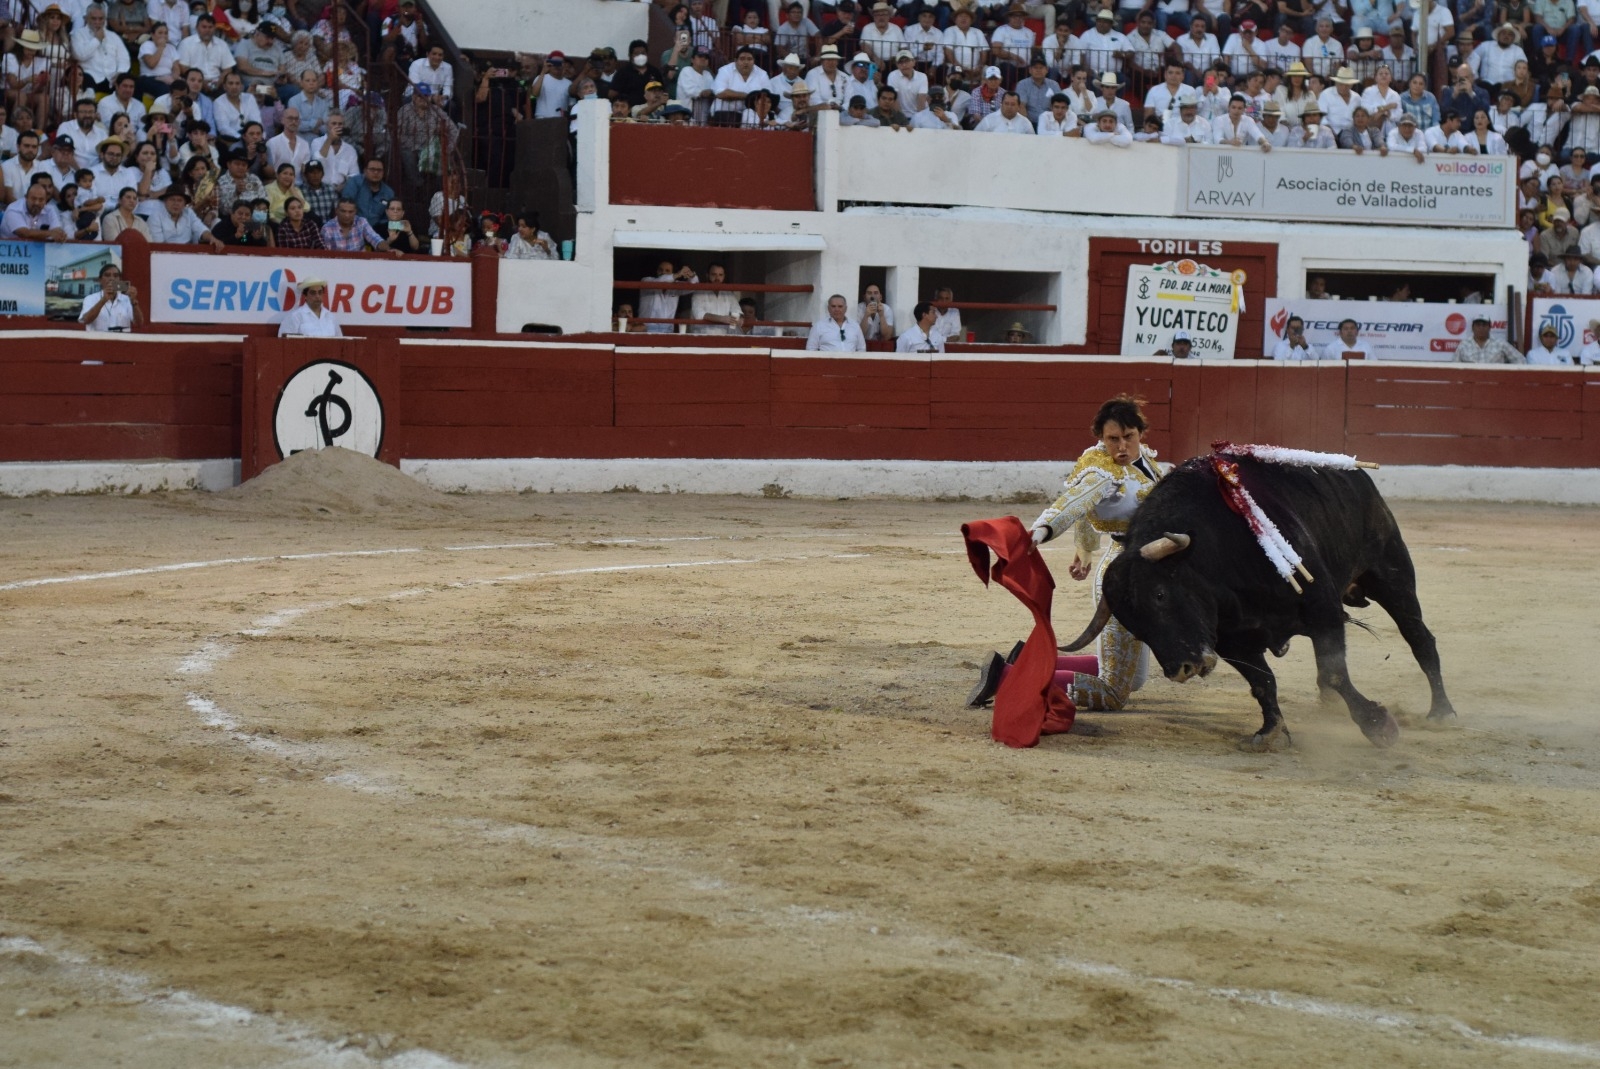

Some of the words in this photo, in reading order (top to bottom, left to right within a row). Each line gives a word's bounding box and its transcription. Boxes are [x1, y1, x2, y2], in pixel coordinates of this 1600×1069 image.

[1435, 162, 1503, 175] valladolid
[1276, 177, 1362, 193] Asociación
[1366, 180, 1386, 193] de
[1391, 181, 1493, 197] Restaurantes
[1194, 190, 1256, 207] ARVAY
[1336, 193, 1357, 206] de
[1361, 194, 1437, 209] Valladolid
[1137, 239, 1223, 255] TORILES
[0, 263, 29, 276] CIALES
[1159, 278, 1179, 291] FDO.
[1181, 280, 1193, 291] DE
[1195, 282, 1206, 293] LA
[1207, 283, 1232, 295] MORA
[361, 284, 455, 315] CLUB
[1136, 305, 1229, 333] YUCATECO
[1304, 320, 1424, 333] TECTERMA
